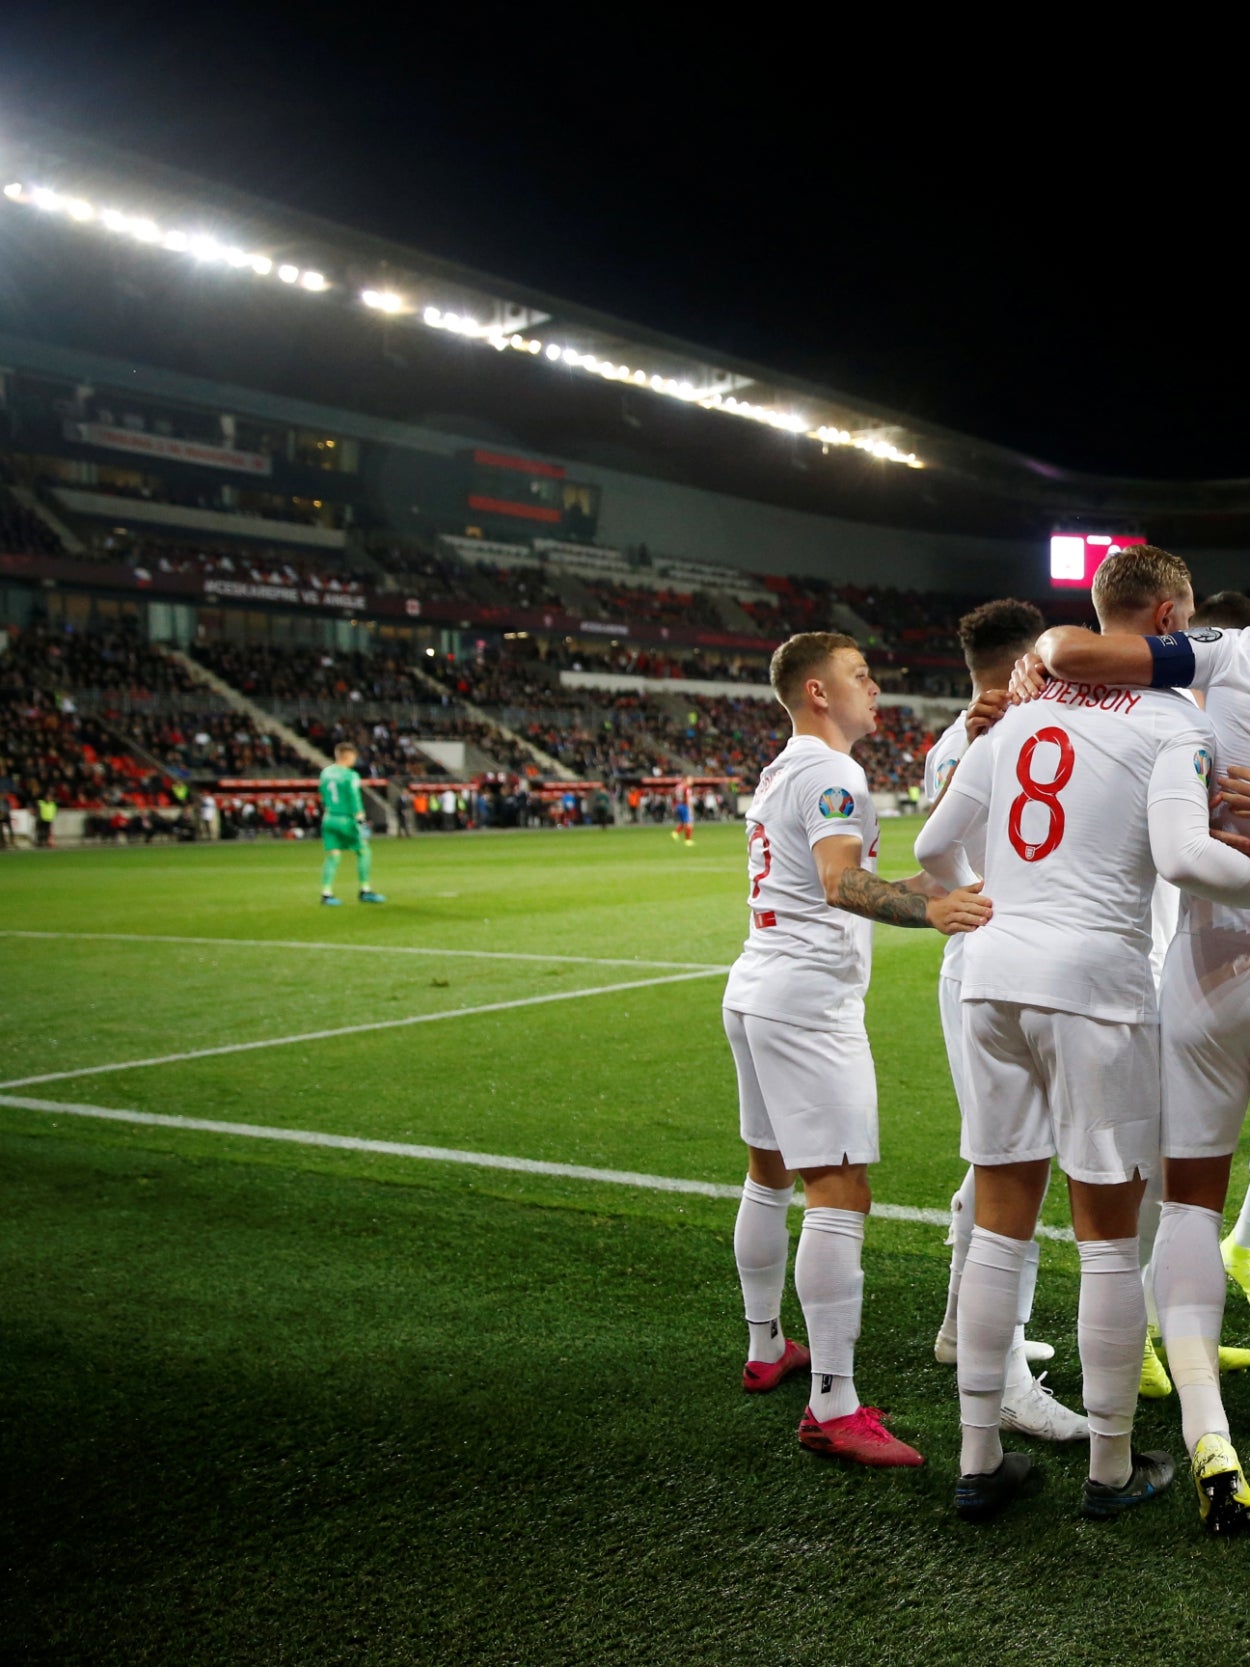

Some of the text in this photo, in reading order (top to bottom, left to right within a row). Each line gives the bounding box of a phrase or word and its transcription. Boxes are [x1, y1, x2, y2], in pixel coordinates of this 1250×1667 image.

[1038, 679, 1141, 714] DERSON
[326, 781, 339, 804] 1
[1008, 726, 1075, 862] 8
